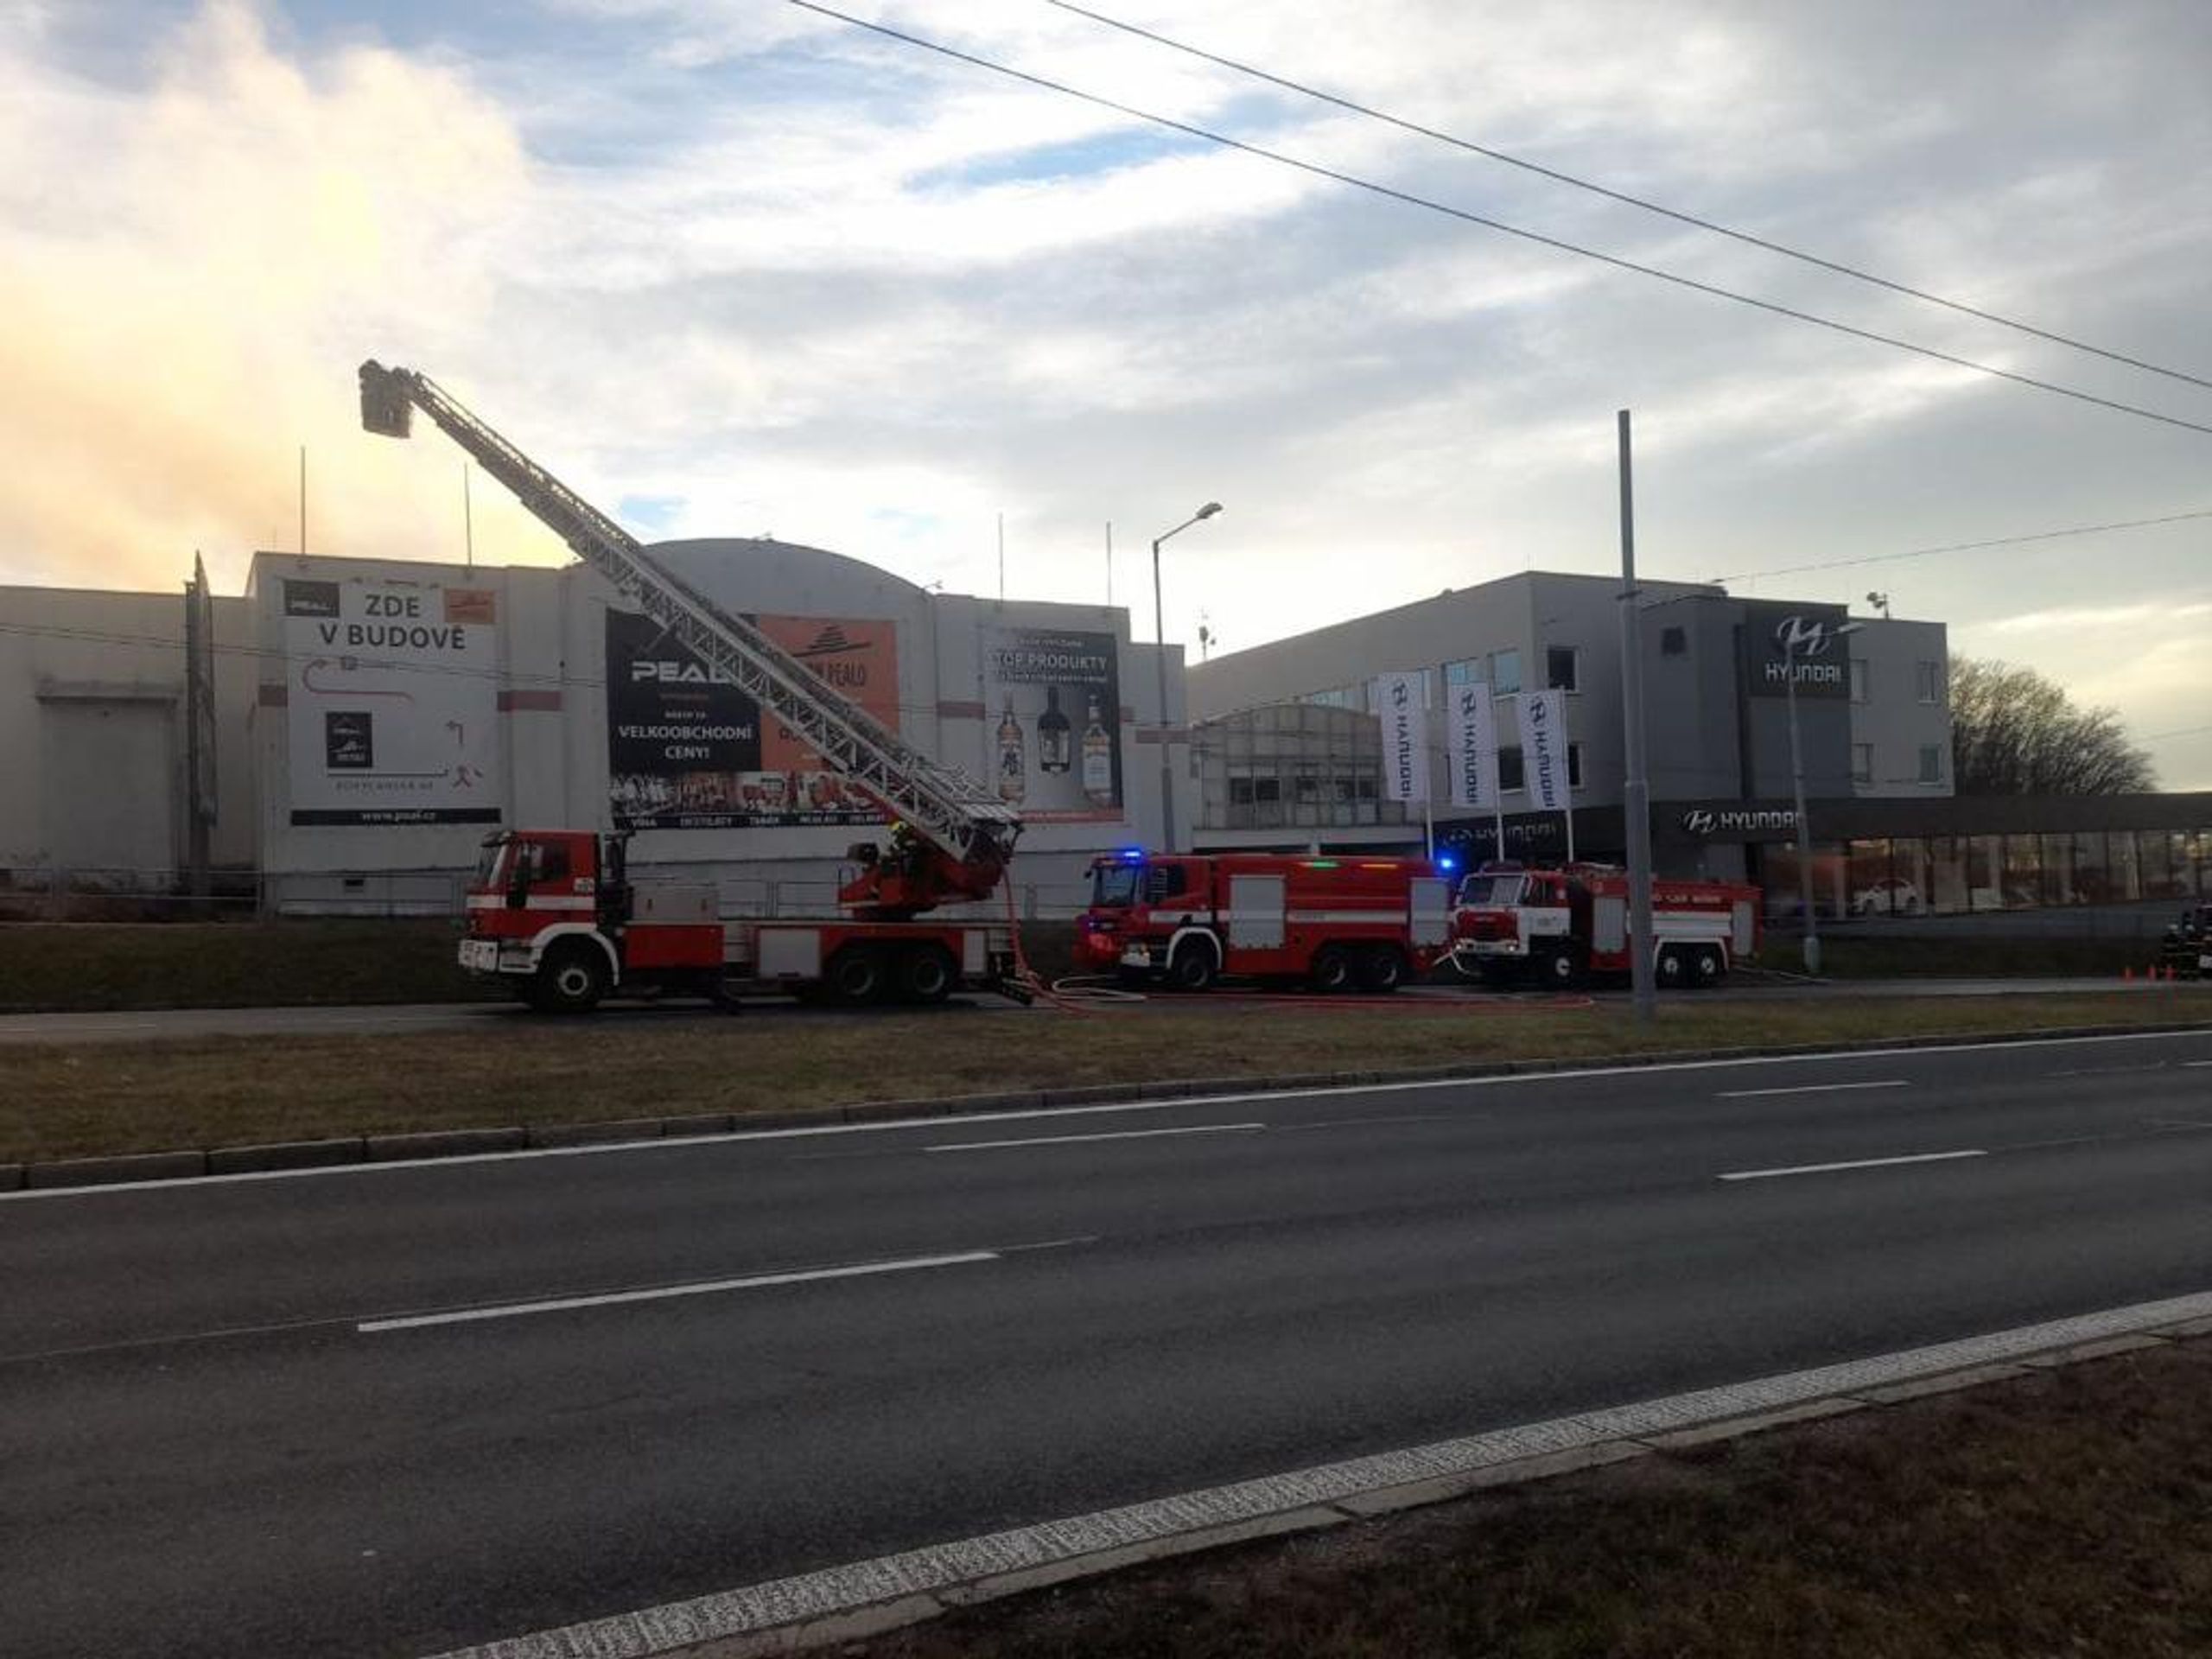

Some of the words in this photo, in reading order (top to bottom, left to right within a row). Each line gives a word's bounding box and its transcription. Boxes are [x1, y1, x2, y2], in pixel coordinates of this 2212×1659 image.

[365, 594, 421, 618] ZDE
[320, 623, 338, 645] V
[348, 624, 467, 650] BUDOVĚ
[1028, 652, 1107, 671] PRODUKTY
[1765, 664, 1840, 682] HYUNDAI
[618, 723, 753, 741] VELKOOBCHODNÍ
[664, 746, 710, 760] CENY!
